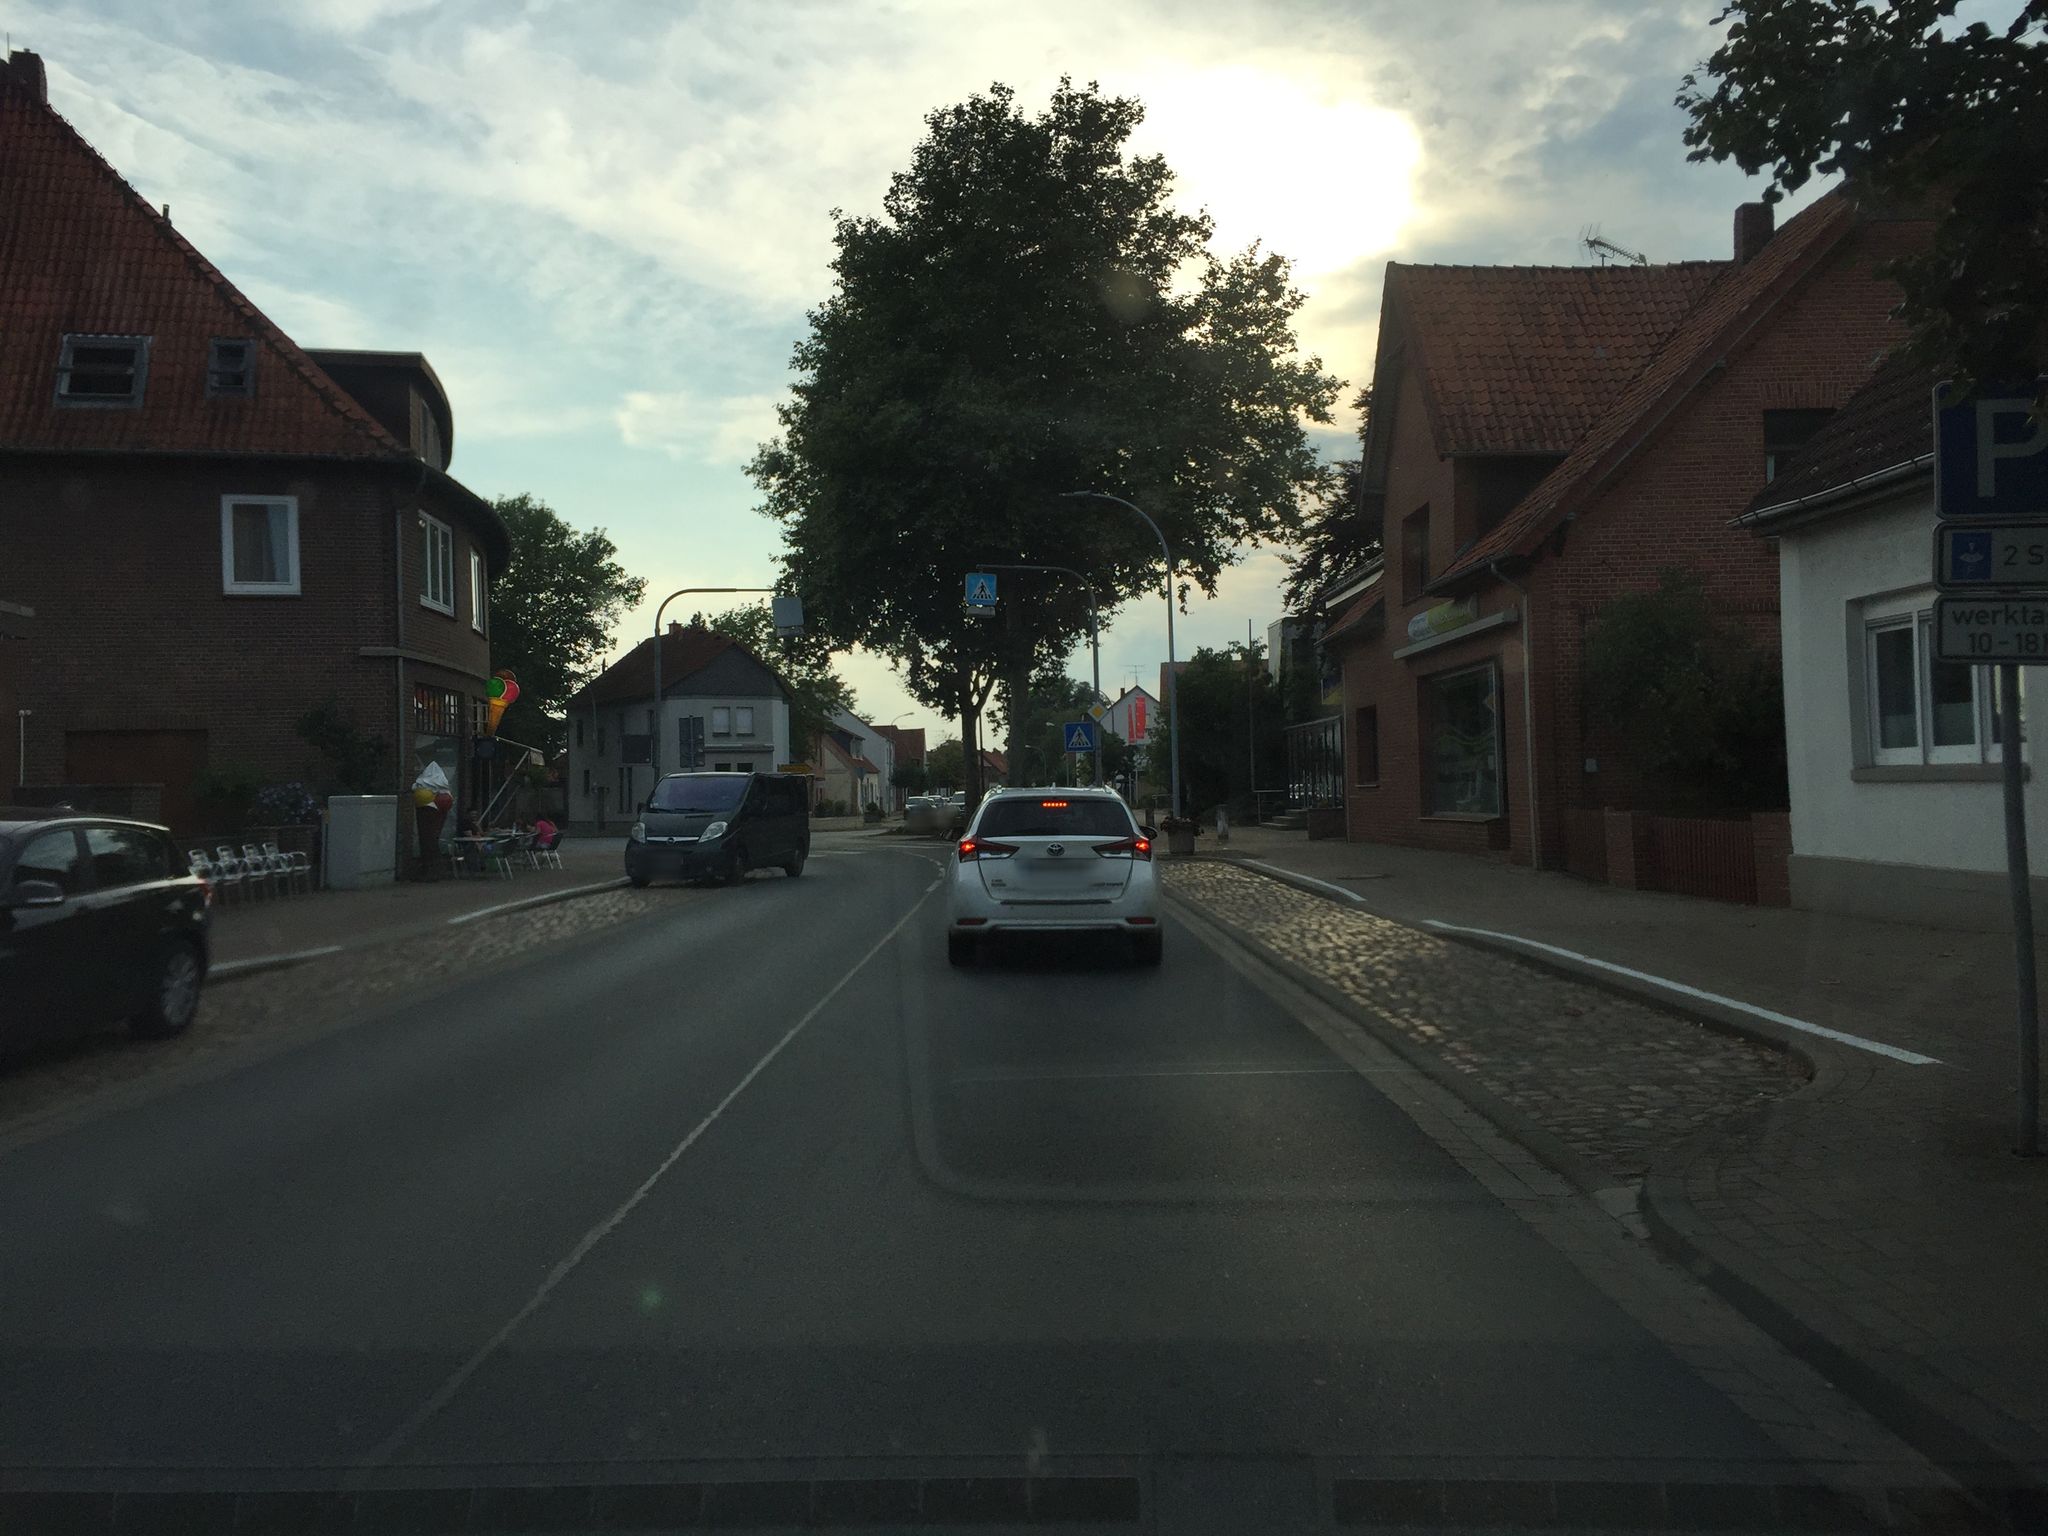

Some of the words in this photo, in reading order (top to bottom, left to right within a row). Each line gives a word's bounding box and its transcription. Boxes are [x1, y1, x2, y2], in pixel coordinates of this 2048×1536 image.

[1976, 399, 2048, 497] P
[2004, 545, 2018, 566] 2
[2028, 545, 2048, 566] S
[1952, 605, 2048, 625] werkta
